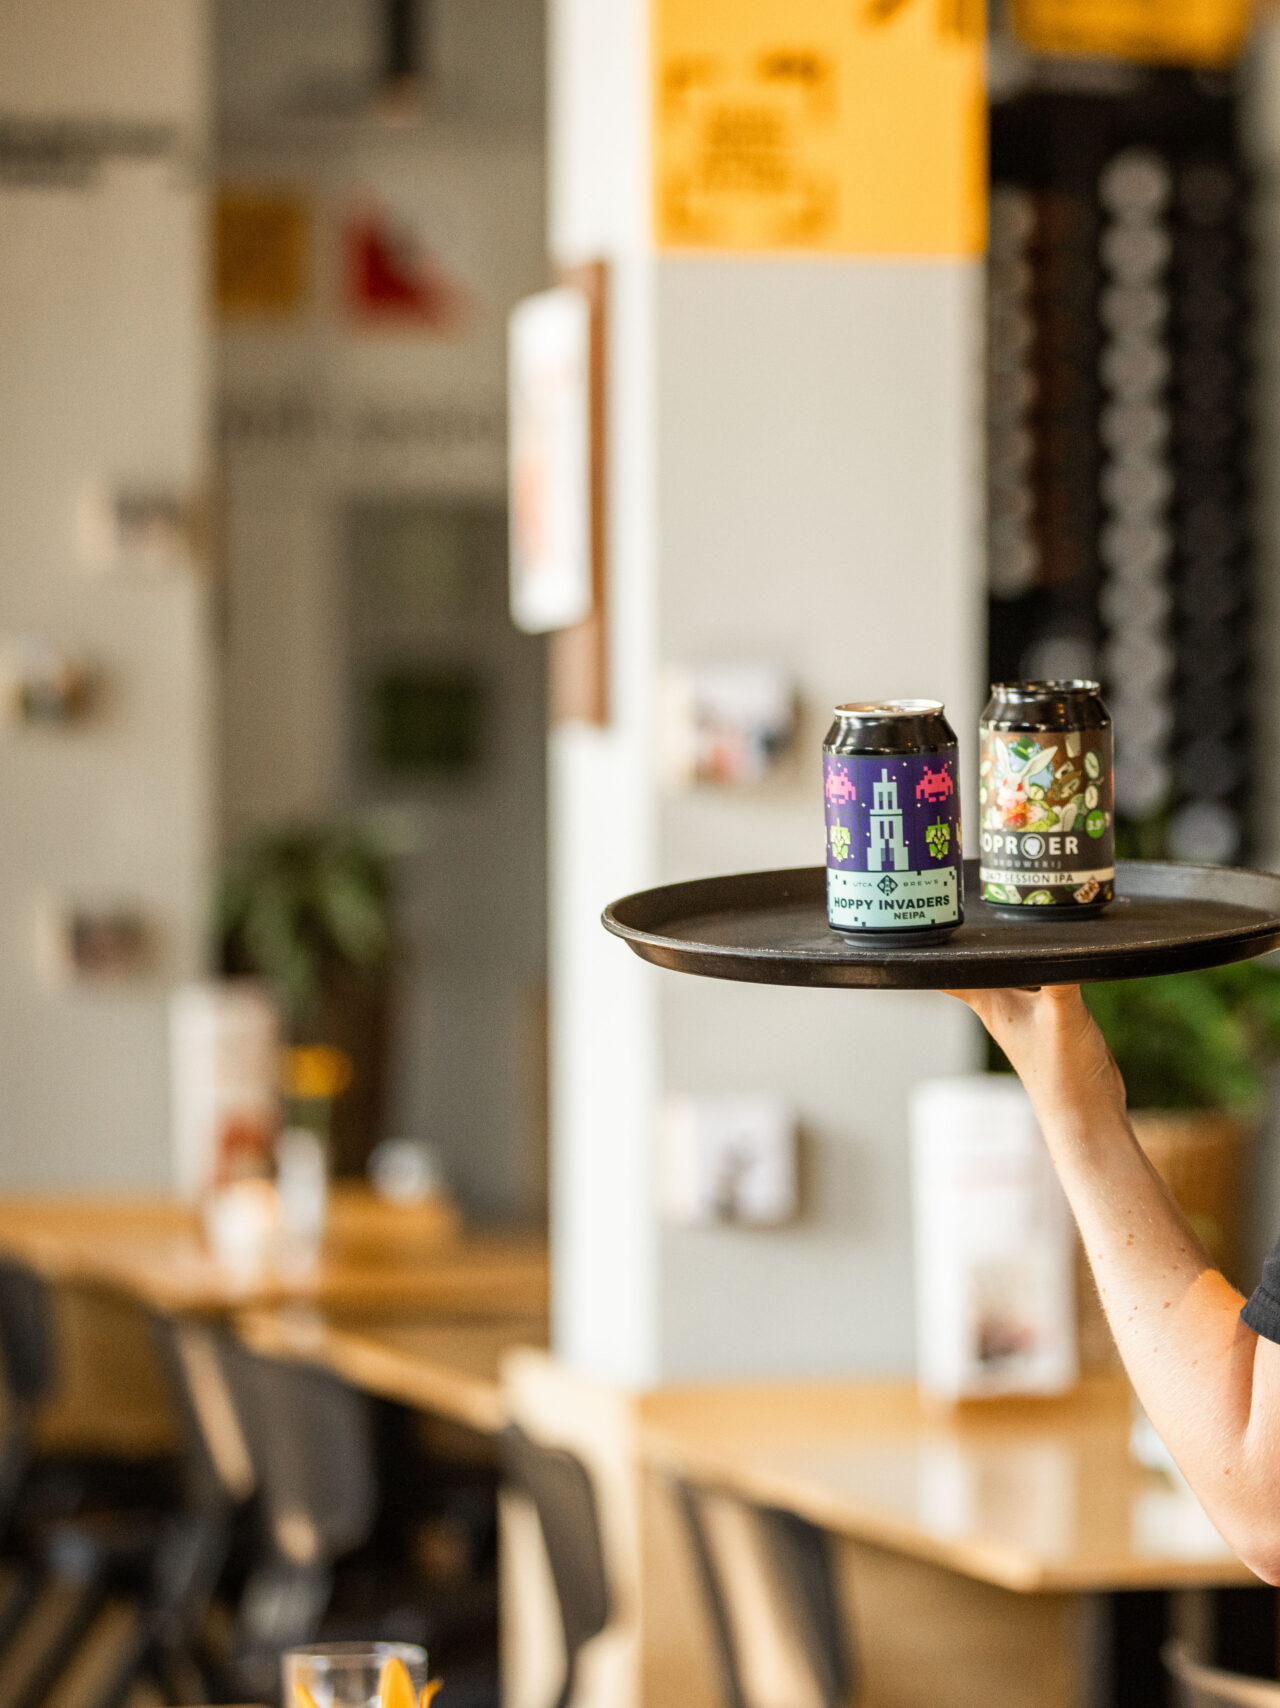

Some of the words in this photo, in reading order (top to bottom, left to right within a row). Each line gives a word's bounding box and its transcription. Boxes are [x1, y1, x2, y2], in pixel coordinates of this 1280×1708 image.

[1004, 873, 1050, 884] SESSION
[1054, 874, 1075, 883] IPA
[834, 897, 873, 910] HOPPY
[878, 895, 950, 910] INVADERS
[894, 911, 926, 920] NEIPA
